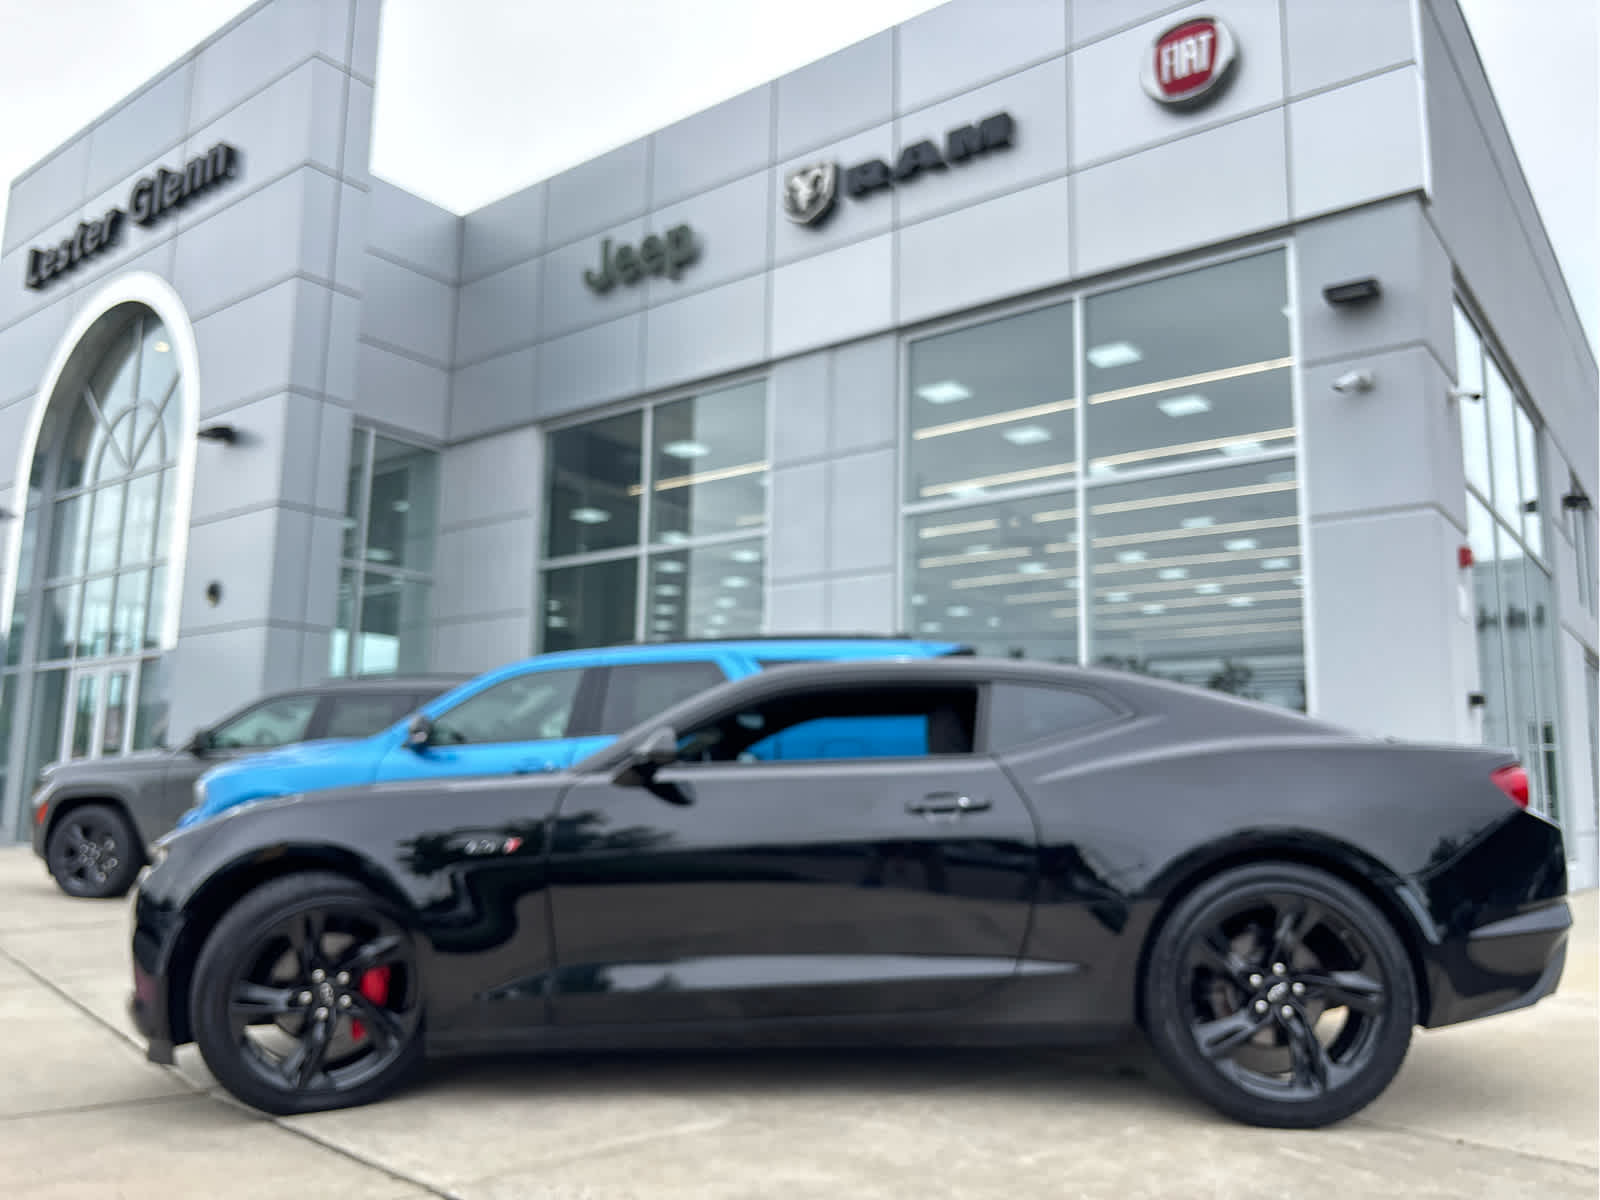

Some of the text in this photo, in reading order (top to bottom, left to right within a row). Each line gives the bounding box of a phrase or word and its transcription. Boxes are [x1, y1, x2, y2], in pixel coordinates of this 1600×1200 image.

[1161, 31, 1213, 85] FIAT
[845, 112, 1015, 199] RAM
[25, 142, 236, 290] Lester Glenn
[585, 223, 701, 293] Jeep
